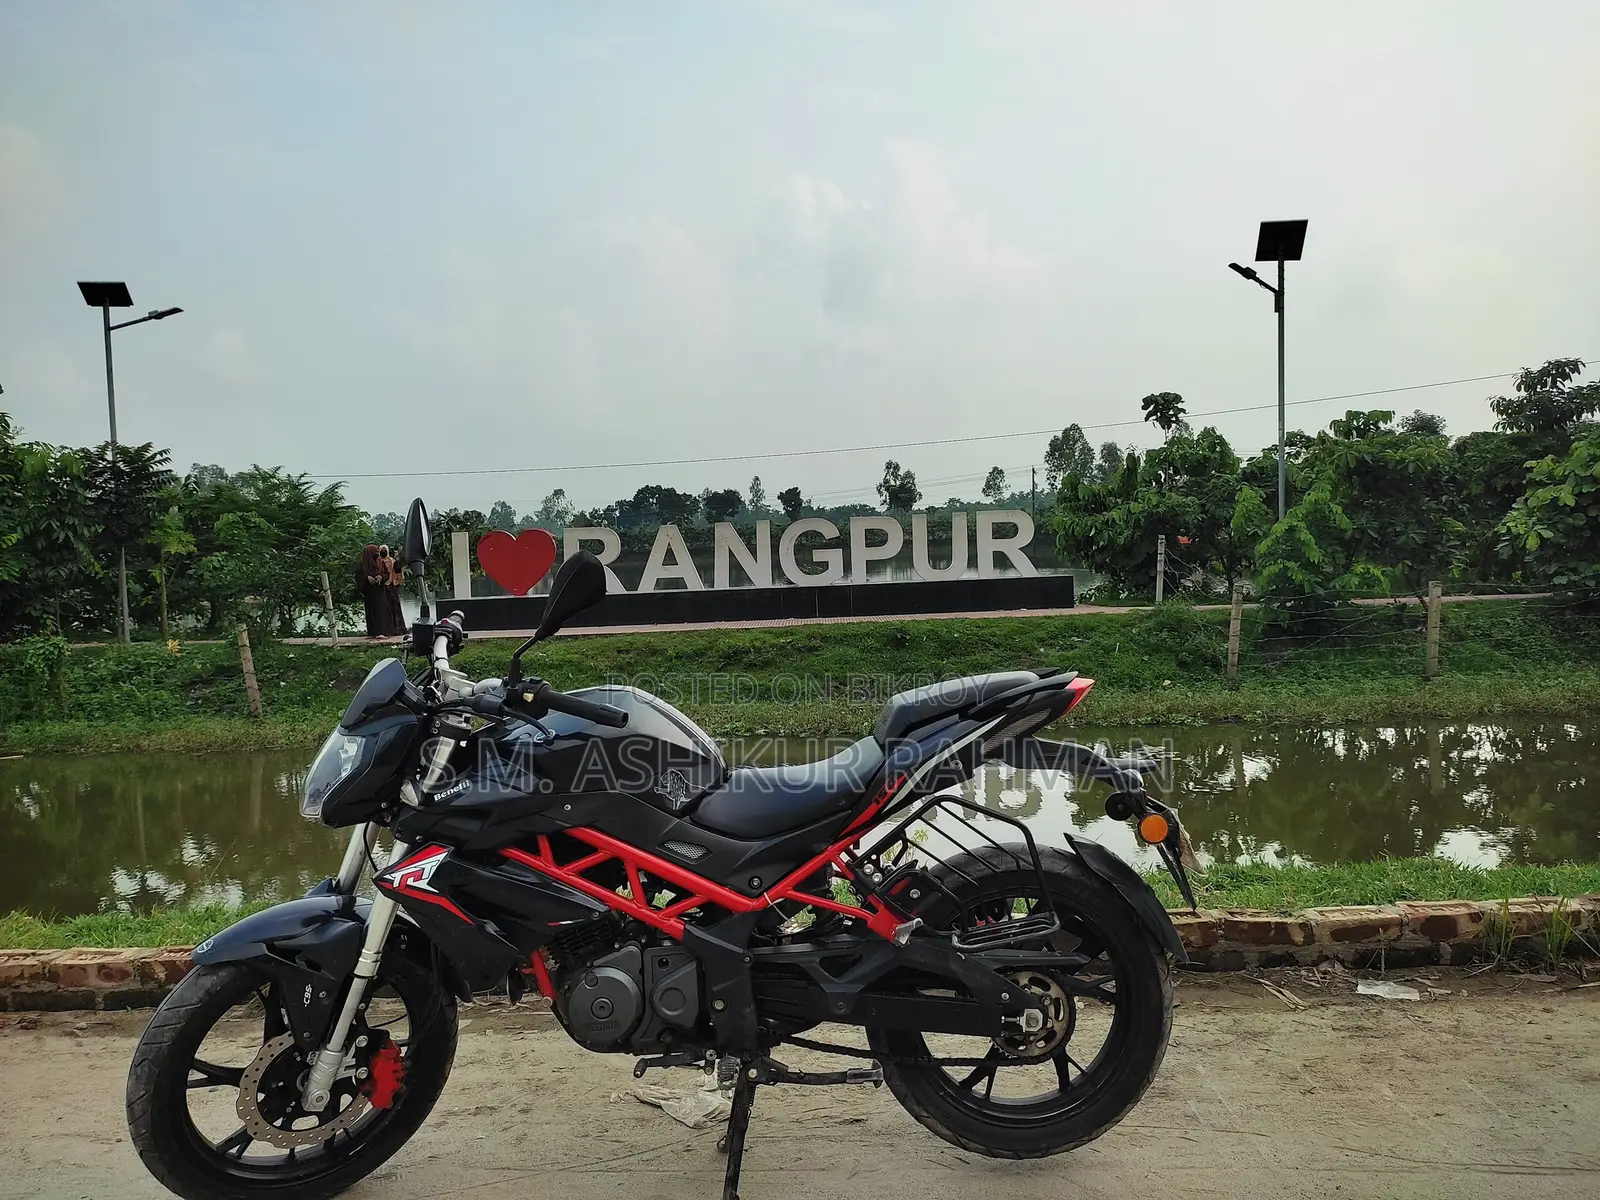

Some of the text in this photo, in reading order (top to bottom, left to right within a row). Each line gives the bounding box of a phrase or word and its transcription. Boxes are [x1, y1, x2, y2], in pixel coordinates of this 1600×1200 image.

[451, 509, 1039, 598] I RANGPUR
[433, 780, 471, 801] Benelli
